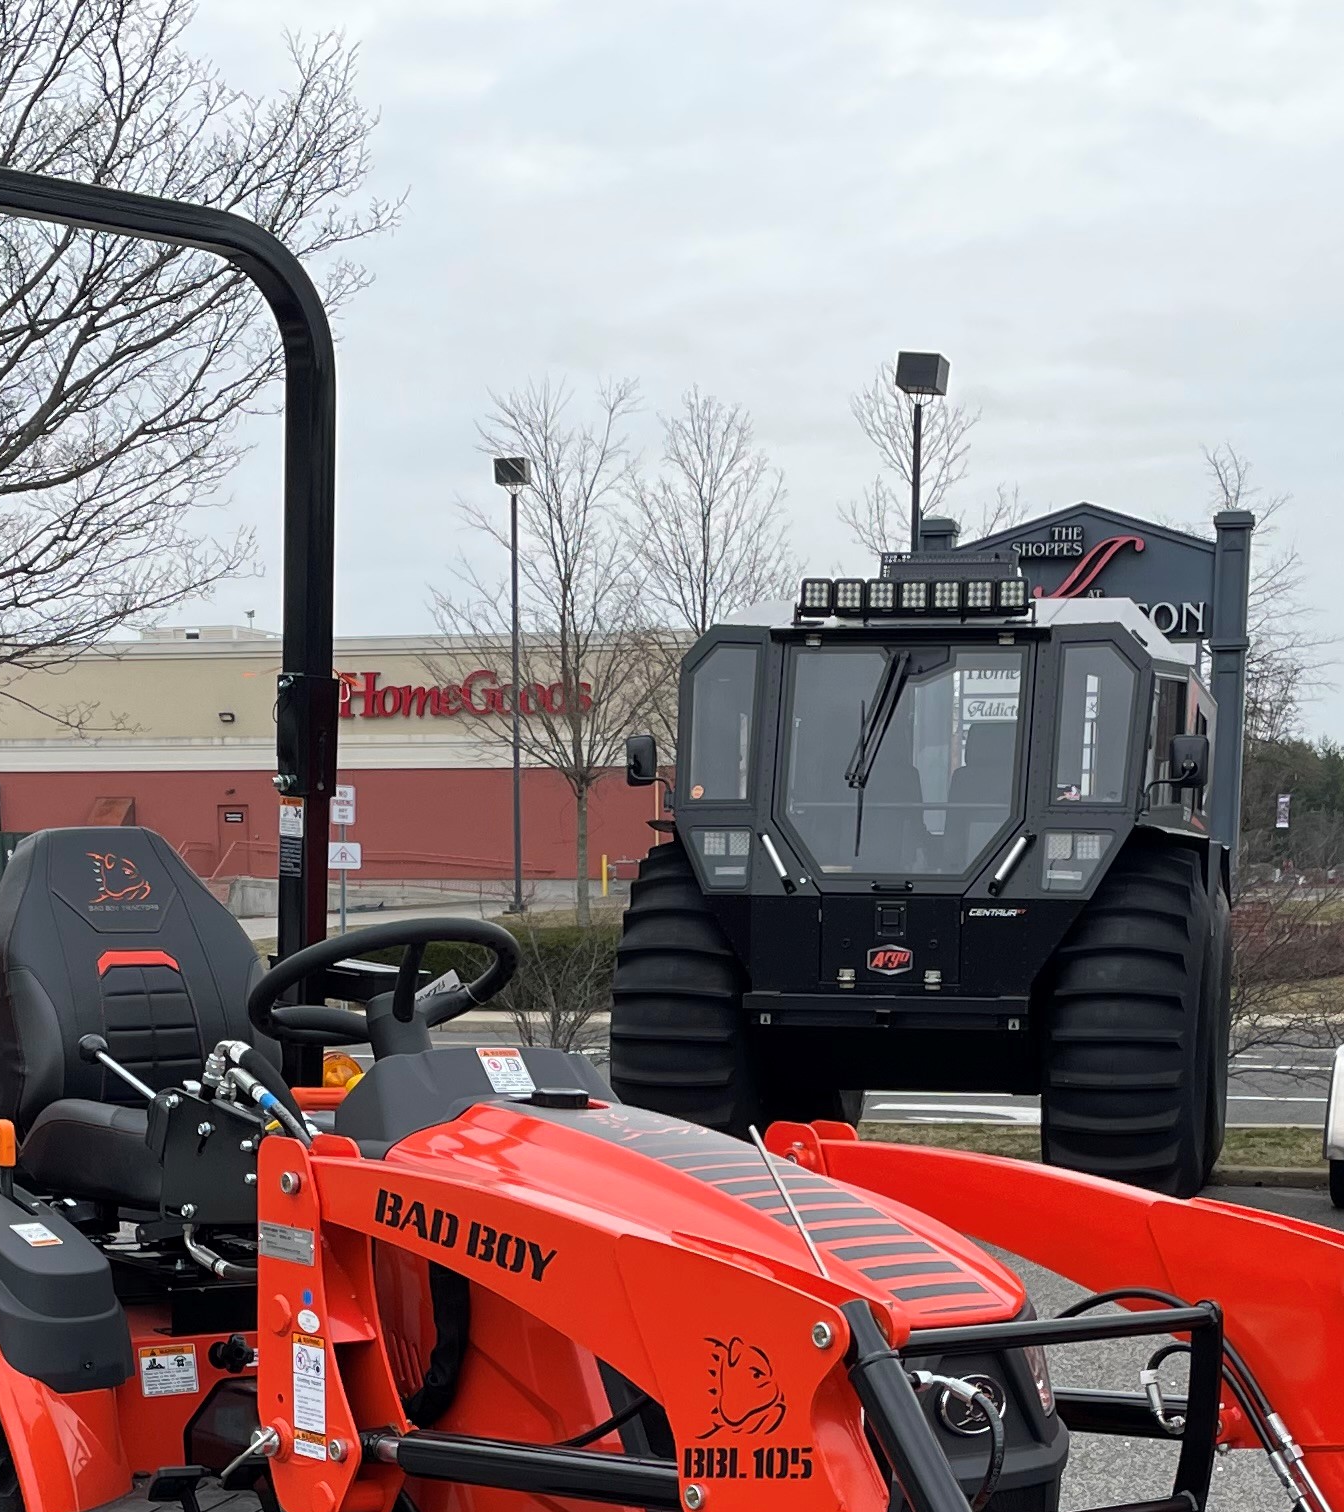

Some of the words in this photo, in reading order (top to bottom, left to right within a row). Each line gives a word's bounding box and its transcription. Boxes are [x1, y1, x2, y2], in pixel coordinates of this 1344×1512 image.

[1051, 526, 1083, 541] THE
[1012, 542, 1084, 556] SHOPPES
[1087, 589, 1103, 598] AT
[340, 669, 592, 718] HomeGoods
[967, 700, 1019, 717] Addict
[968, 908, 1018, 917] CENTAUR
[871, 951, 911, 969] Argo
[374, 1188, 459, 1249] BAD
[466, 1221, 558, 1282] BOY
[684, 1447, 747, 1479] BBL
[753, 1447, 813, 1479] 105
